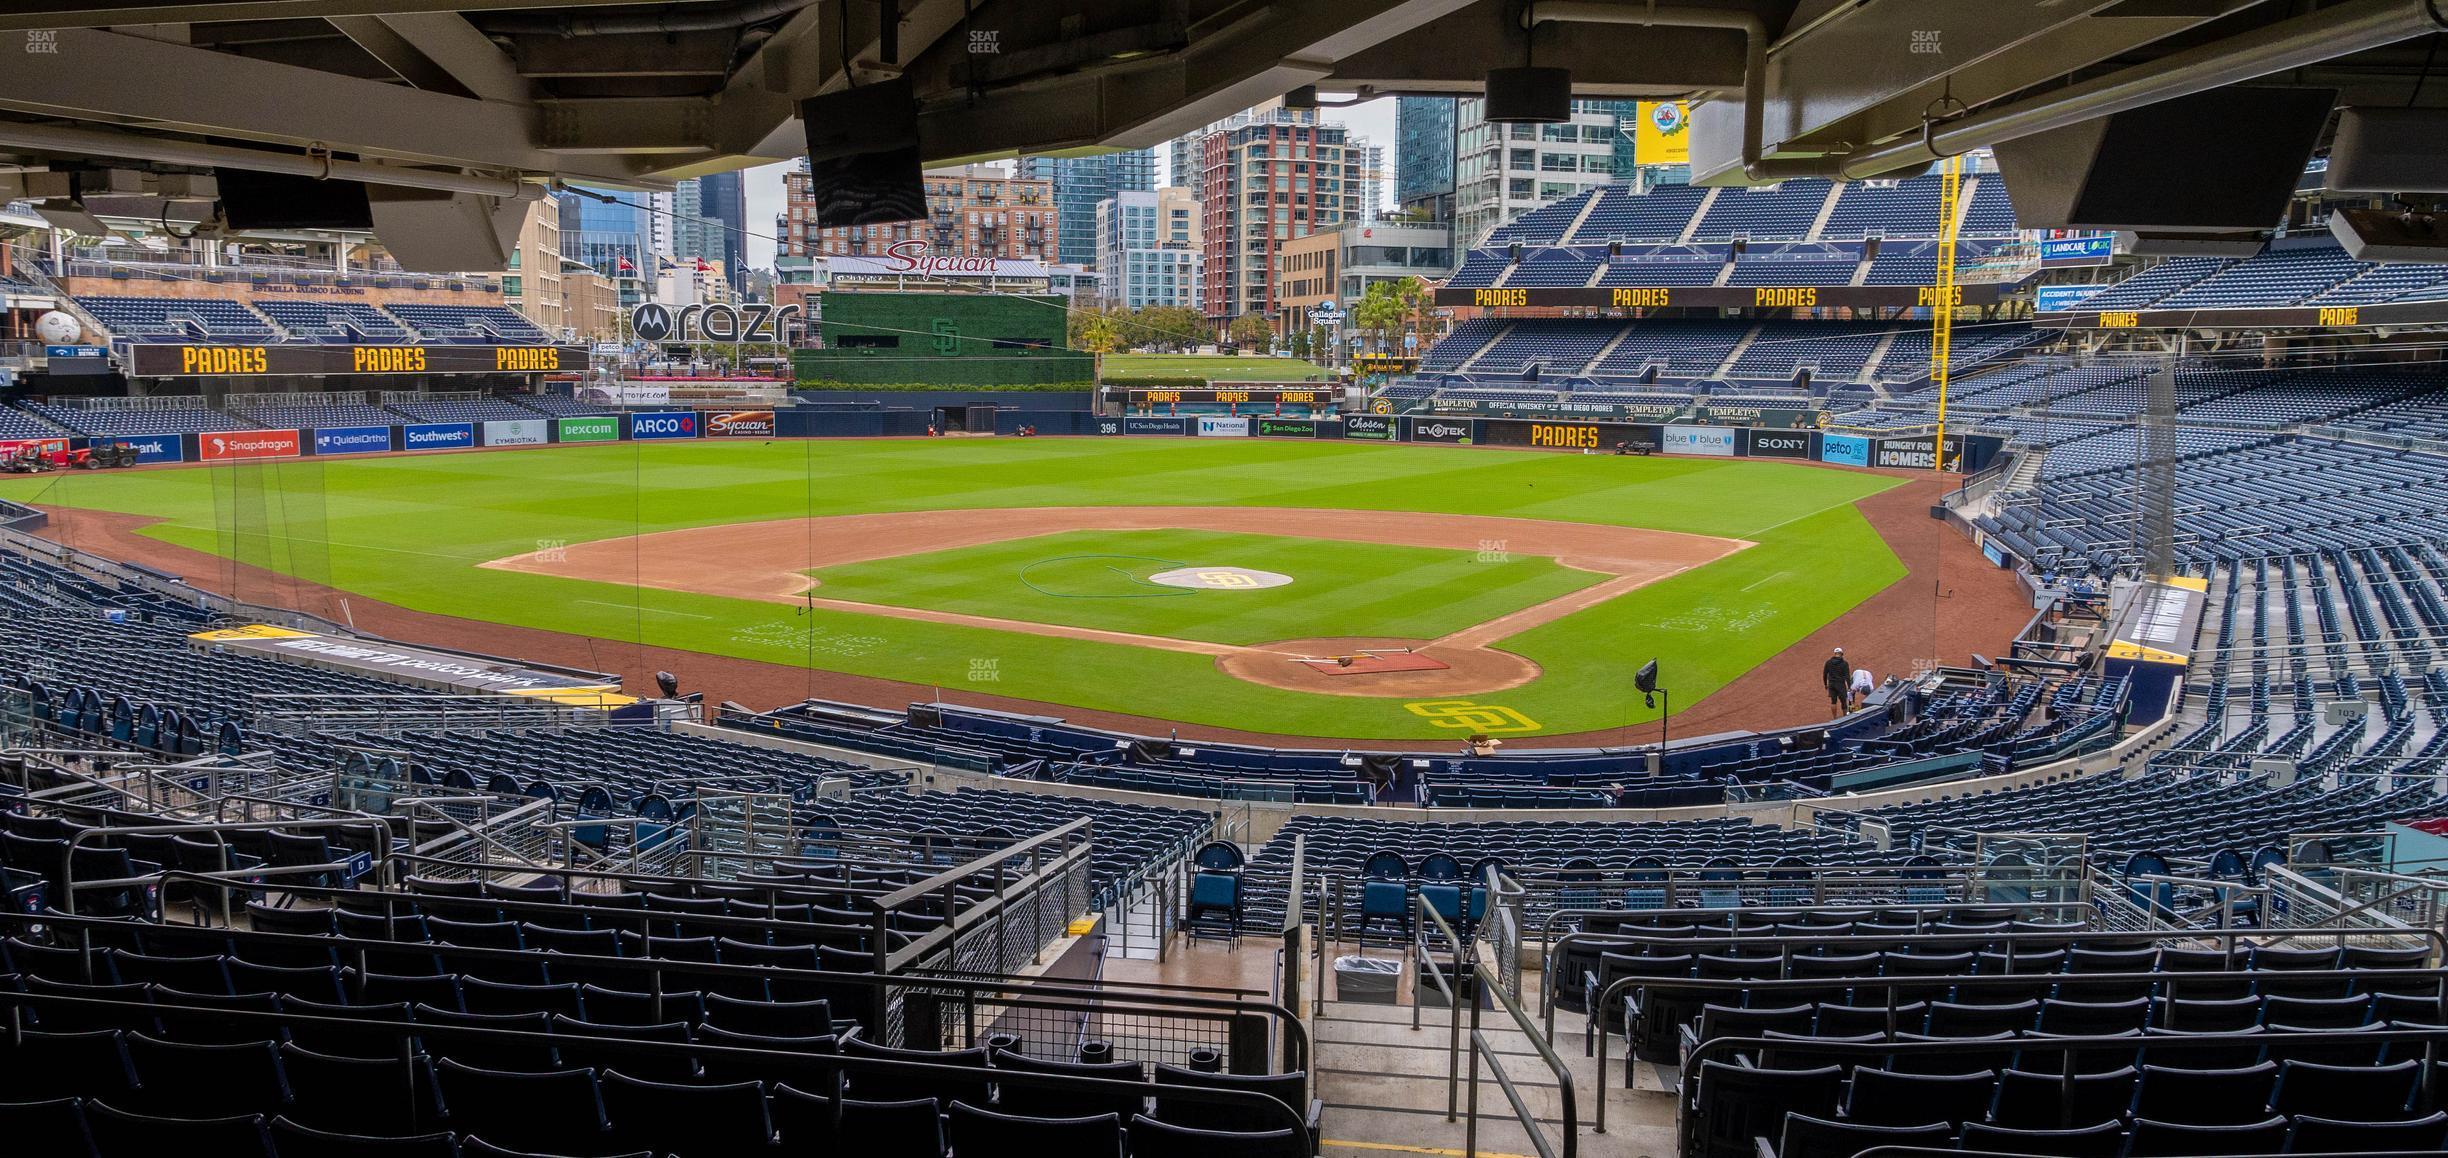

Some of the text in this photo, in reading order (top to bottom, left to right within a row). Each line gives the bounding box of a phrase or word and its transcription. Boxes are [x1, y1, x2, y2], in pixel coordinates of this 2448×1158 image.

[2052, 240, 2110, 252] LANDCARE LOGIC
[886, 239, 1000, 281] Sycuan
[253, 285, 365, 295] ESTRELLA JALISCO LANDING
[1475, 289, 1527, 306] PADRES
[1613, 288, 1668, 306] PADRES
[1756, 288, 1816, 306] PADRES
[1308, 310, 1346, 319] Gallagher
[2100, 312, 2138, 328] PADRES
[2319, 308, 2358, 326] PADRES
[676, 303, 801, 342] razr
[1313, 317, 1341, 325] Square
[182, 347, 267, 373] PADRES
[354, 347, 426, 372] PADRES
[497, 347, 558, 370] PADRES
[1147, 391, 1180, 402] PADRES
[1216, 391, 1249, 402] PADRES
[1282, 392, 1314, 402] PADRES
[1432, 399, 1478, 408] TEMPLETON
[1488, 402, 1517, 410] OFFICIAL
[1517, 402, 1546, 410] WHISKEY
[1573, 404, 1590, 412] DIEGO
[1624, 405, 1676, 415] TEMPLETON
[1707, 407, 1761, 418] TEMPLETON
[634, 419, 679, 433] ARCO
[710, 414, 768, 435] Sycuan
[1100, 423, 1117, 434] 396
[1139, 422, 1148, 430] San
[1148, 422, 1163, 430] Diego
[1348, 417, 1386, 429] Chosen
[333, 434, 387, 445] QuidelOrtho
[408, 431, 464, 442] Southwest
[495, 436, 537, 445] CYMBIOTIKA
[1532, 424, 1598, 448] PADRES
[1665, 434, 1722, 444] blue blue
[229, 438, 294, 451] Snapdragon
[1758, 438, 1805, 450] SONY
[1825, 442, 1852, 454] petco
[1884, 440, 1933, 451] HUNGRY FOR
[1880, 451, 1936, 468] HOMERS
[1403, 701, 1542, 733] SD
[2338, 708, 2356, 718] 103
[828, 789, 844, 799] 104
[358, 860, 364, 870] D
[2278, 900, 2283, 908] F
